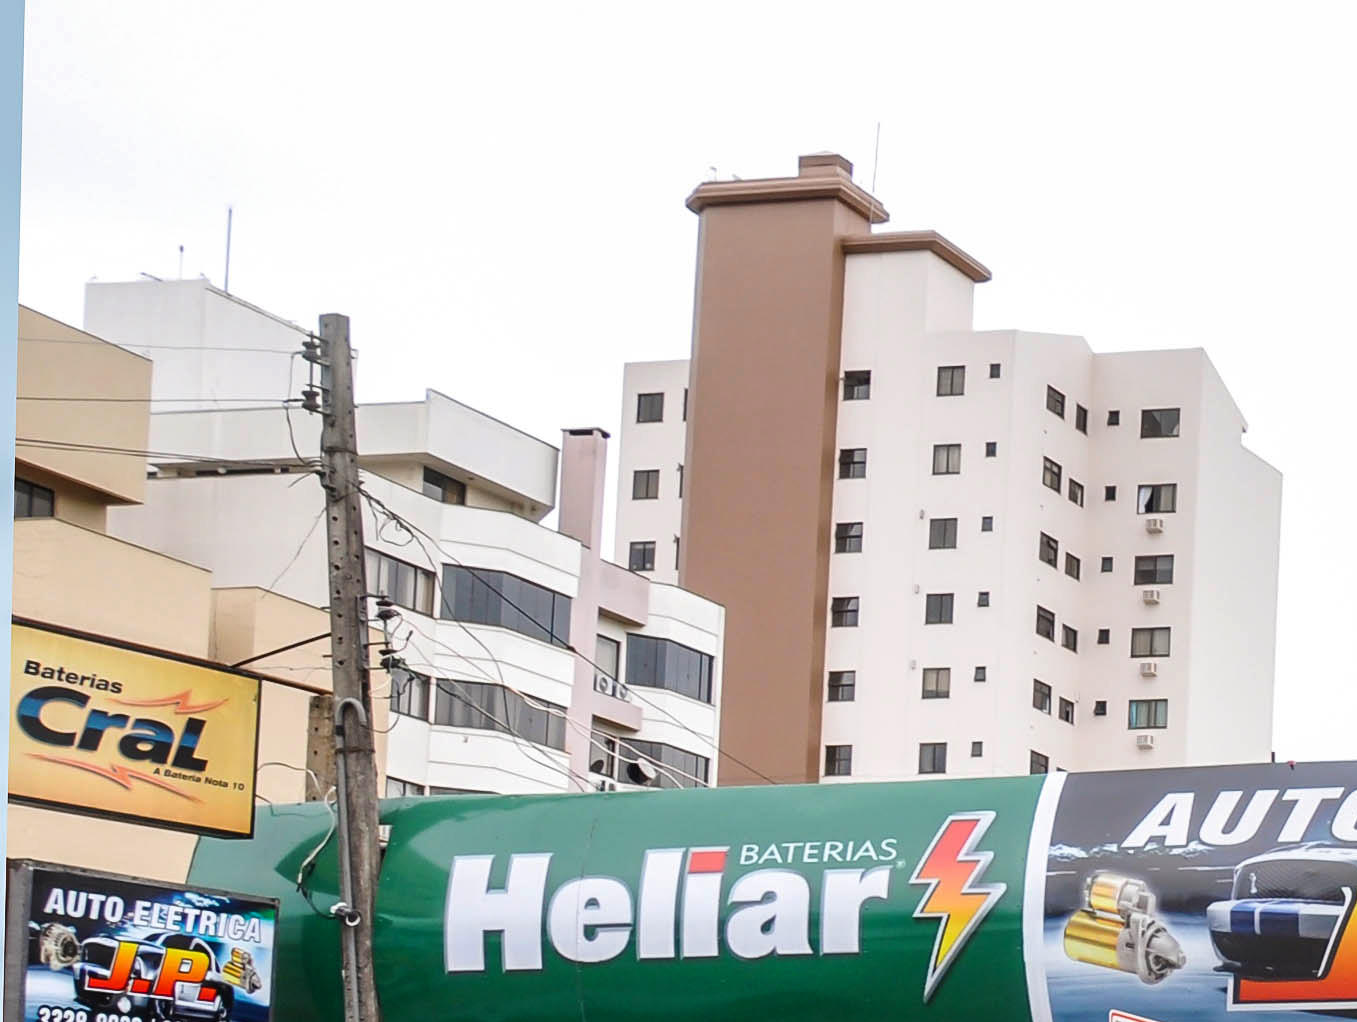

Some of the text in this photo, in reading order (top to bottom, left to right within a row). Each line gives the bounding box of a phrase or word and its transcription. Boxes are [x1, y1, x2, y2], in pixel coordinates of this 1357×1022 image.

[23, 659, 123, 694] Baterias
[164, 769, 201, 783] Bateria
[205, 777, 229, 788] Nota
[233, 782, 245, 791] 10
[739, 838, 898, 866] BATERIAS
[43, 887, 124, 923] AUTO
[444, 846, 890, 973] Heliar
[84, 940, 218, 1003] J.P.
